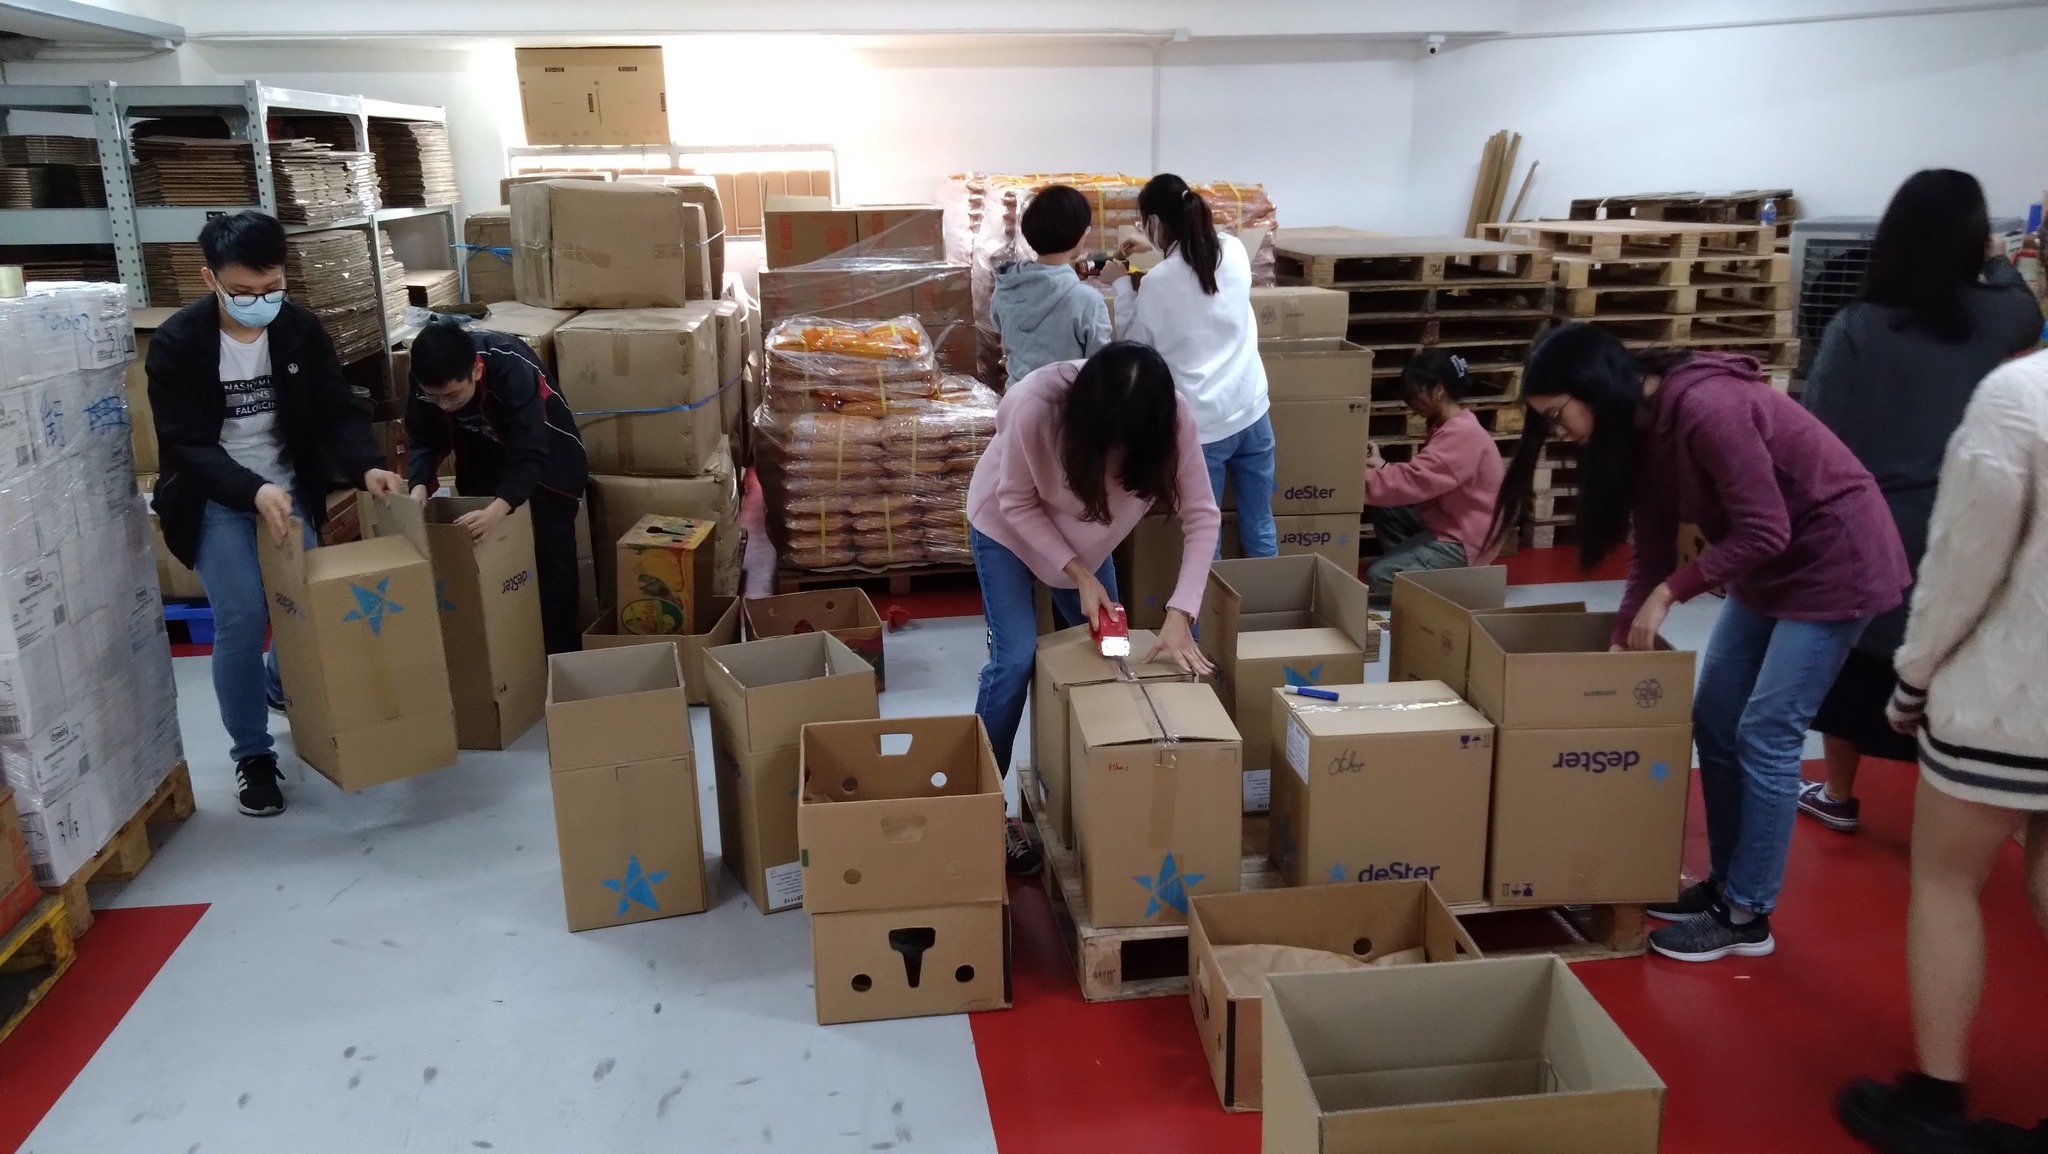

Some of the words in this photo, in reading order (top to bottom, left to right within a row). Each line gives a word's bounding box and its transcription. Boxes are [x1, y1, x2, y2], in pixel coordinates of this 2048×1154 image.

[1284, 485, 1336, 500] deSter
[1280, 532, 1331, 547] deSter
[502, 570, 528, 594] deSter
[1552, 750, 1640, 773] deSter
[1358, 862, 1440, 882] deSter
